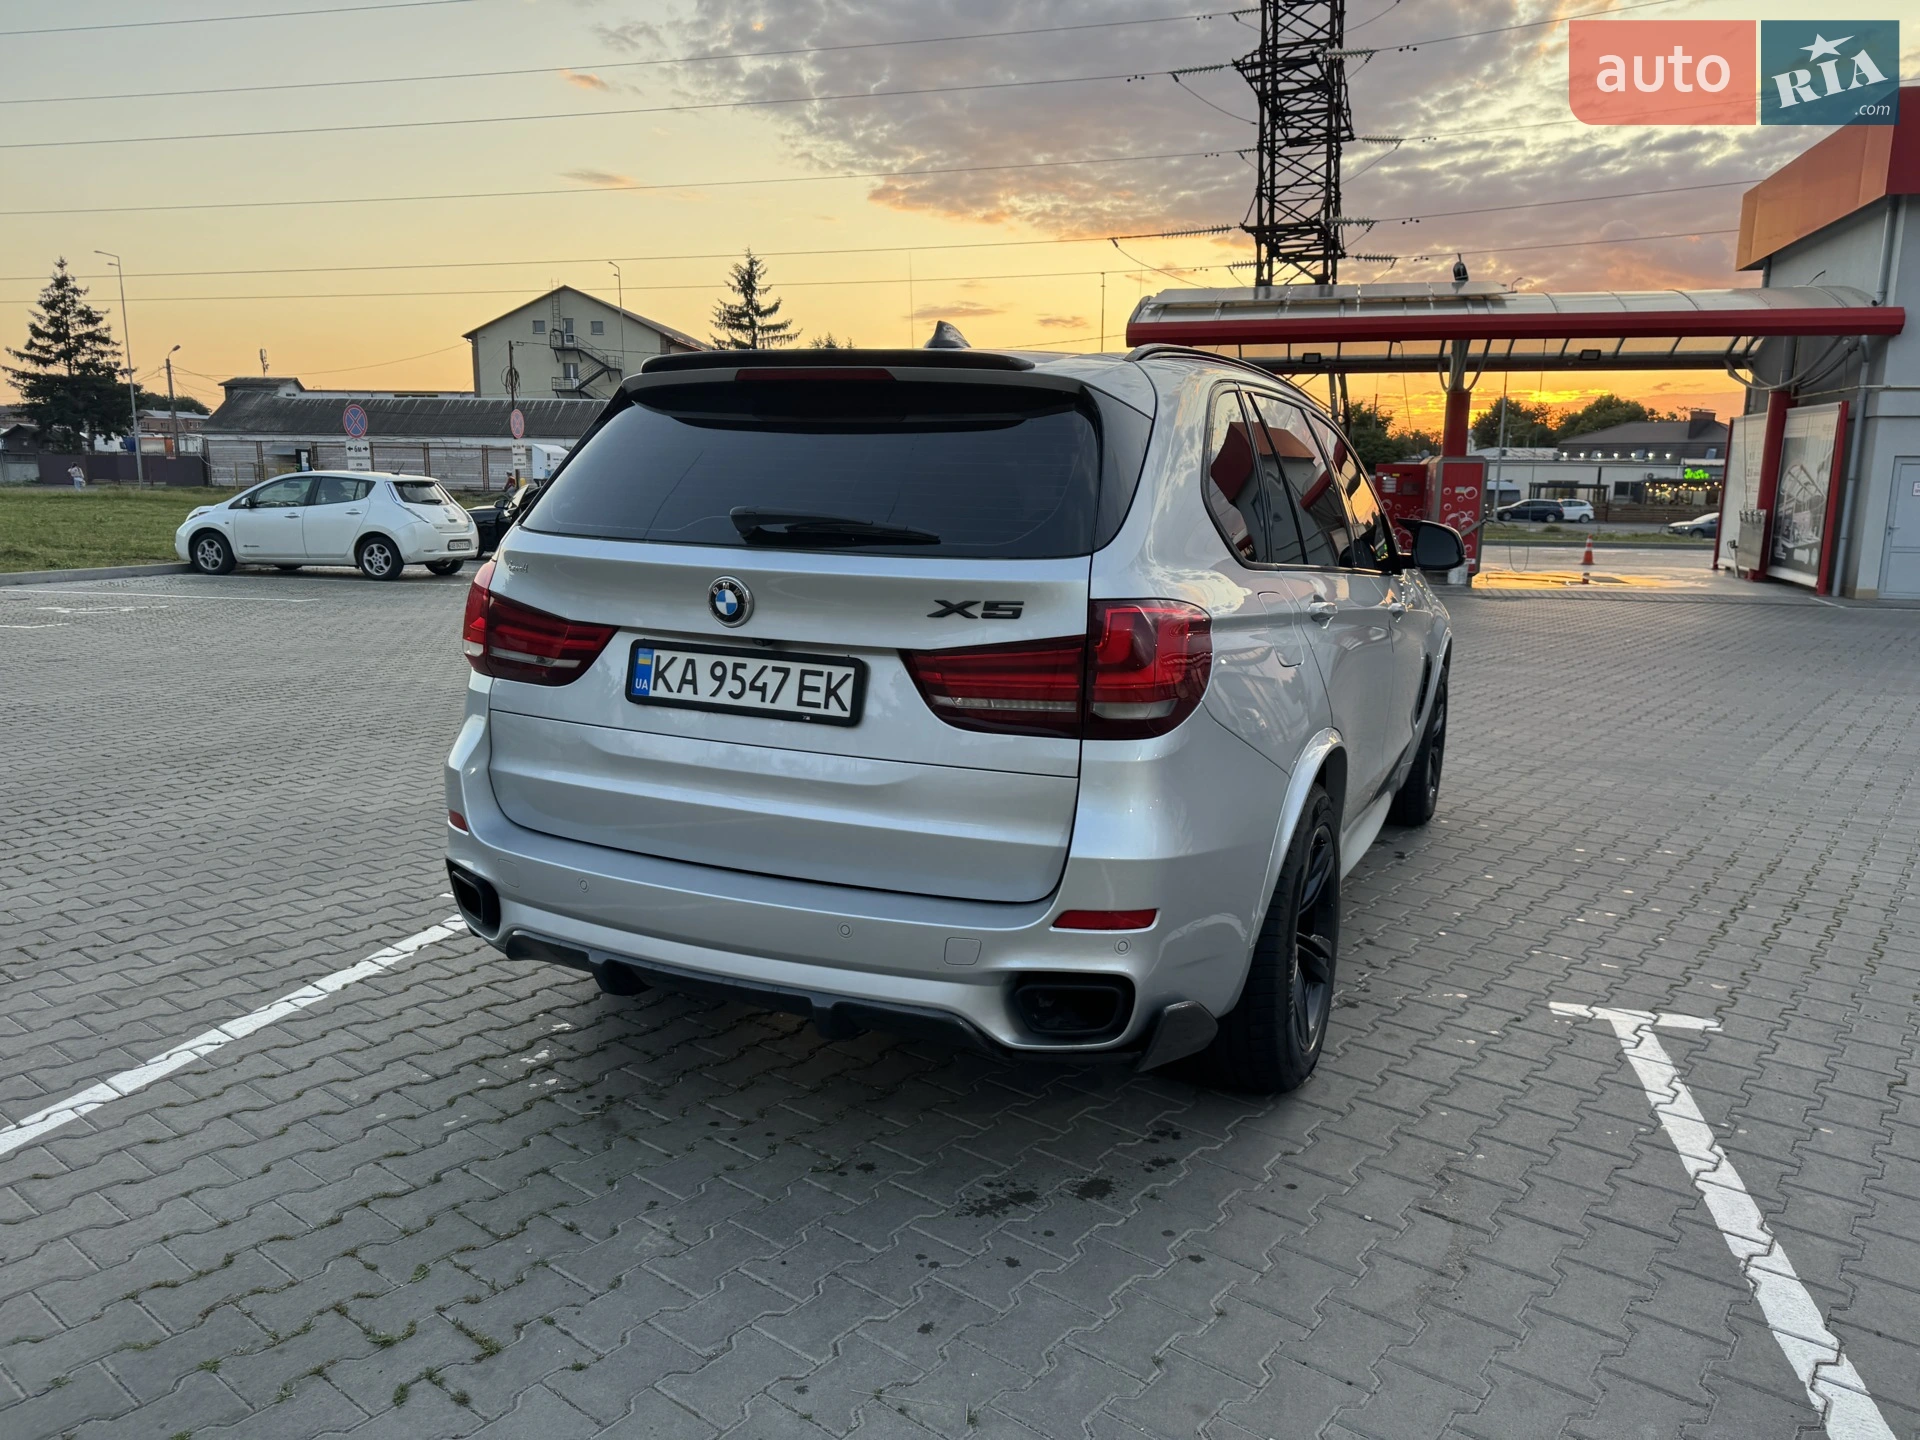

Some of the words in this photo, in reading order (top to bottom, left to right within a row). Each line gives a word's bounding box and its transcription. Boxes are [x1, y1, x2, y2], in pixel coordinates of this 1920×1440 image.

[712, 582, 742, 597] BMW
[926, 600, 1024, 619] X5
[635, 678, 648, 690] UA
[652, 655, 698, 695] KA
[709, 660, 791, 704] 9547
[797, 669, 852, 711] EK
